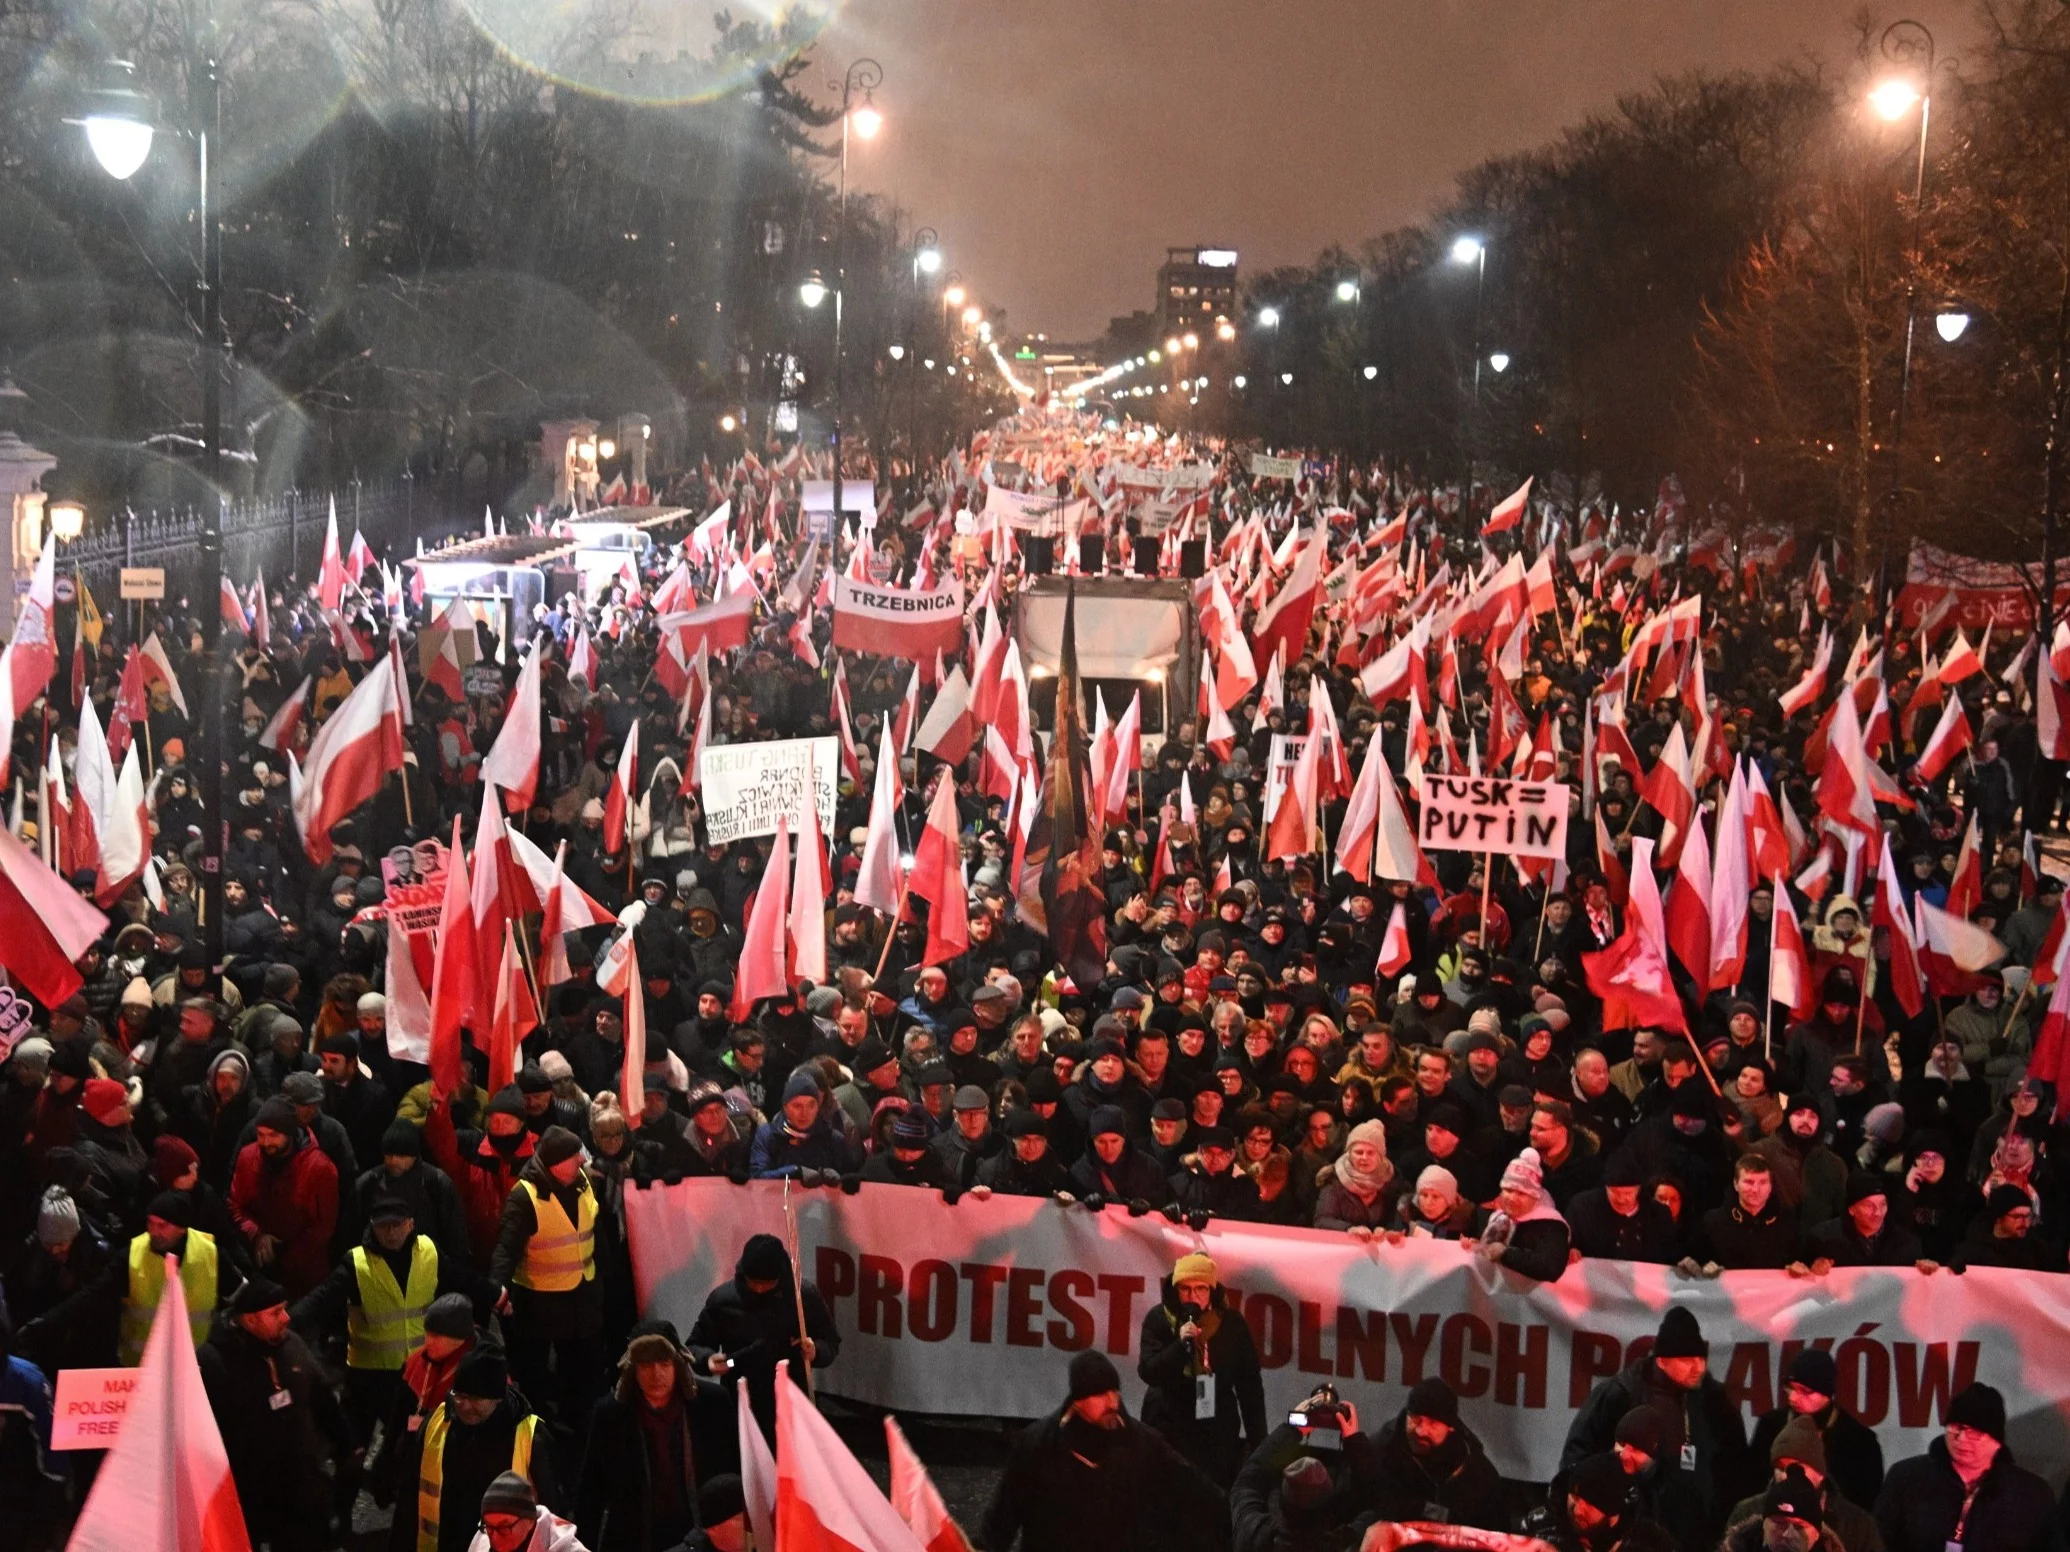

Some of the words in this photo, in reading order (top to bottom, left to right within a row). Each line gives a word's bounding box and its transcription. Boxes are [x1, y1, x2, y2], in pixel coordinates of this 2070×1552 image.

[849, 588, 956, 612] TRZEBNICA
[815, 1246, 1145, 1356] PROTEST
[1160, 1273, 1550, 1409] OLNYCH
[68, 1401, 126, 1415] POLISH
